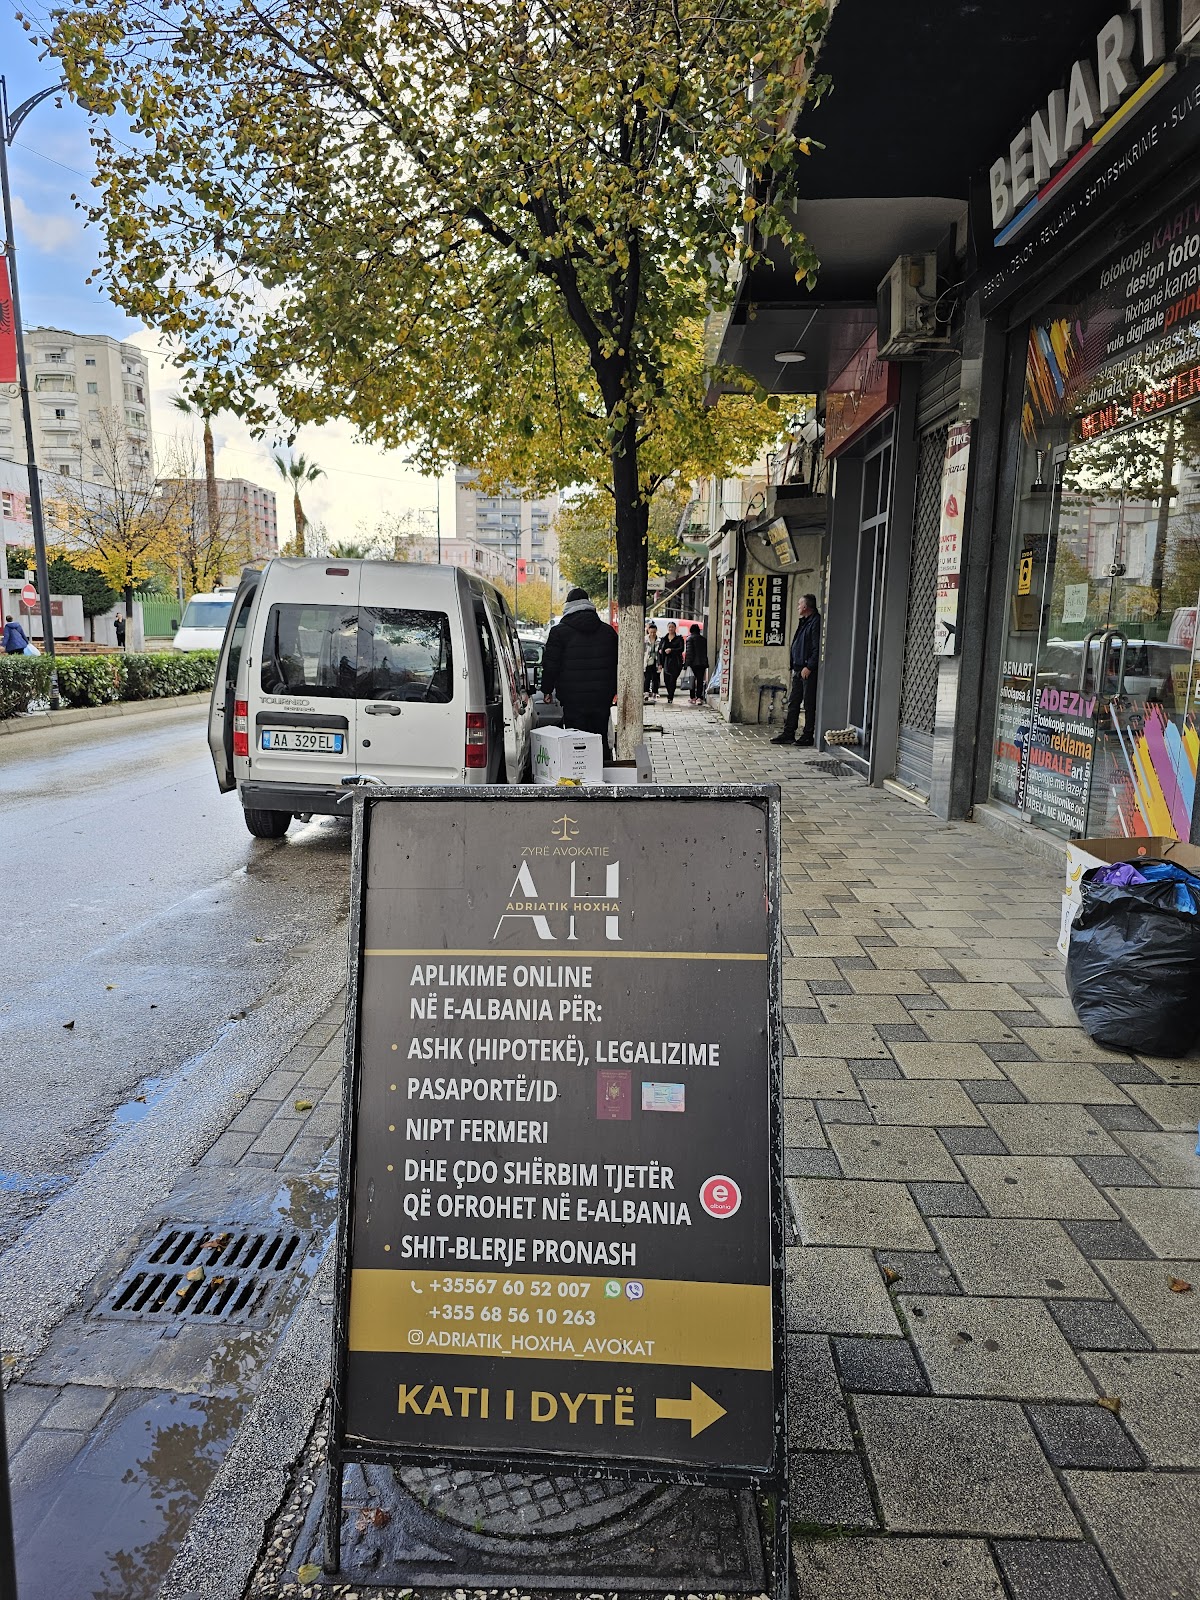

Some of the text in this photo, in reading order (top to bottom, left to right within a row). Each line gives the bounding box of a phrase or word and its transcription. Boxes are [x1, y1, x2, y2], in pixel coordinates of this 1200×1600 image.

[988, 0, 1165, 230] BENART
[1040, 203, 1077, 247] REKLAMA
[1085, 124, 1159, 207] SHTYPSHKRIME
[1100, 241, 1151, 290] fotokopje
[1125, 234, 1200, 298] design foto
[1124, 285, 1163, 323] filxhanë
[1106, 334, 1124, 354] vula
[1126, 311, 1164, 344] digjitale
[1100, 351, 1142, 383] stampime
[1087, 379, 1121, 407] dhurata
[1081, 403, 1118, 438] MENU
[755, 577, 764, 638] VALUTE
[1002, 661, 1033, 677] BENART
[258, 697, 310, 707] TOURNEO
[1031, 688, 1042, 741] branding
[1039, 687, 1097, 719] ADEZIV
[273, 733, 288, 747] AA
[1037, 713, 1095, 738] fotokopje printime
[994, 740, 1020, 763] LETRA
[1035, 730, 1093, 760] logo reklama
[1017, 732, 1029, 809] KARTVIZITA
[1029, 746, 1084, 781] MURALE art
[1026, 783, 1042, 799] tabela
[1042, 790, 1074, 812] elektronike
[1054, 778, 1064, 791] me
[1065, 780, 1082, 797] lazer
[1081, 761, 1091, 804] design
[1025, 796, 1047, 816] TABELA
[520, 845, 609, 857] ZYRË AVOKATIE
[505, 902, 620, 912] ADRIATIK HOXHA
[410, 964, 592, 988] APLIKIME ONLINE
[410, 992, 602, 1022] NË E-ALBANIA PËR:
[407, 1034, 720, 1067] ASHK (HIPOTEKË), LEGALIZIME
[407, 1073, 558, 1103] PASAPORTË/ID
[406, 1118, 548, 1144] NIPT FERMERI
[404, 1156, 675, 1194] DHE ÇDO SHËRBIM TJETËR
[403, 1188, 692, 1226] QË OFROHET NË E-ALBANIA
[401, 1234, 637, 1268] SHIT-BLERJE PRONASH
[429, 1277, 591, 1298] +35567 60 52 007
[429, 1305, 596, 1326] +355 68 56 10 263
[426, 1331, 655, 1357] ADRIATIK_HOXHA_AVOKAT
[397, 1383, 635, 1426] KATI I DYTË
